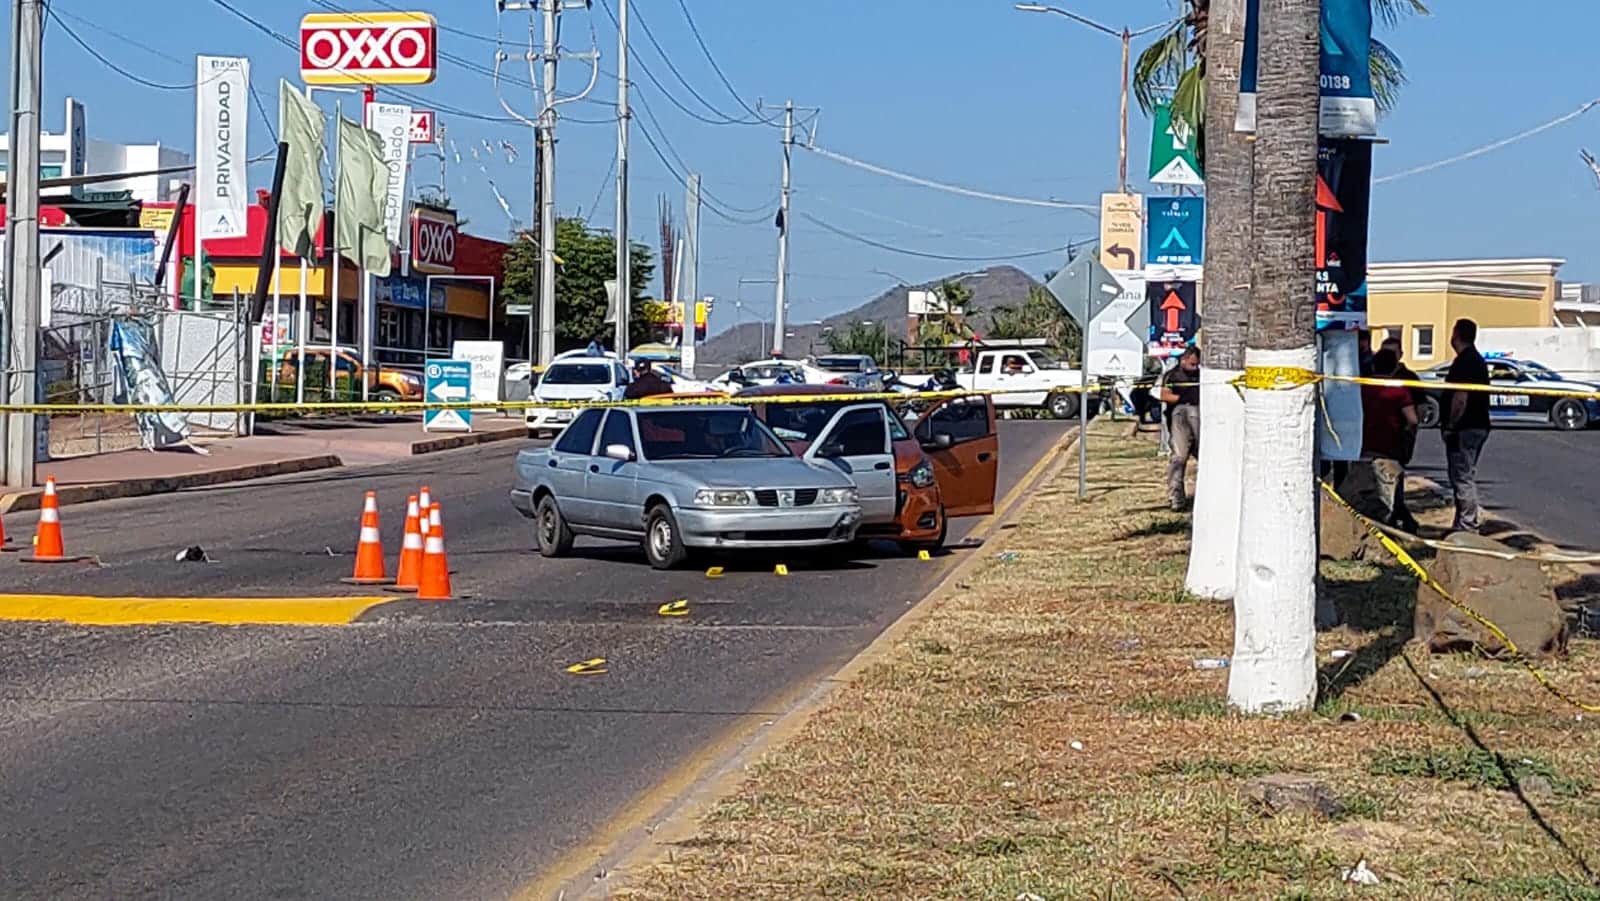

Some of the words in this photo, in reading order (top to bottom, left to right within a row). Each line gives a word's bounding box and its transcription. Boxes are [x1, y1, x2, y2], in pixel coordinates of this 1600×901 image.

[306, 26, 426, 69] OXXO
[216, 81, 231, 198] PRIVACIDAD
[419, 223, 455, 263] OXXO
